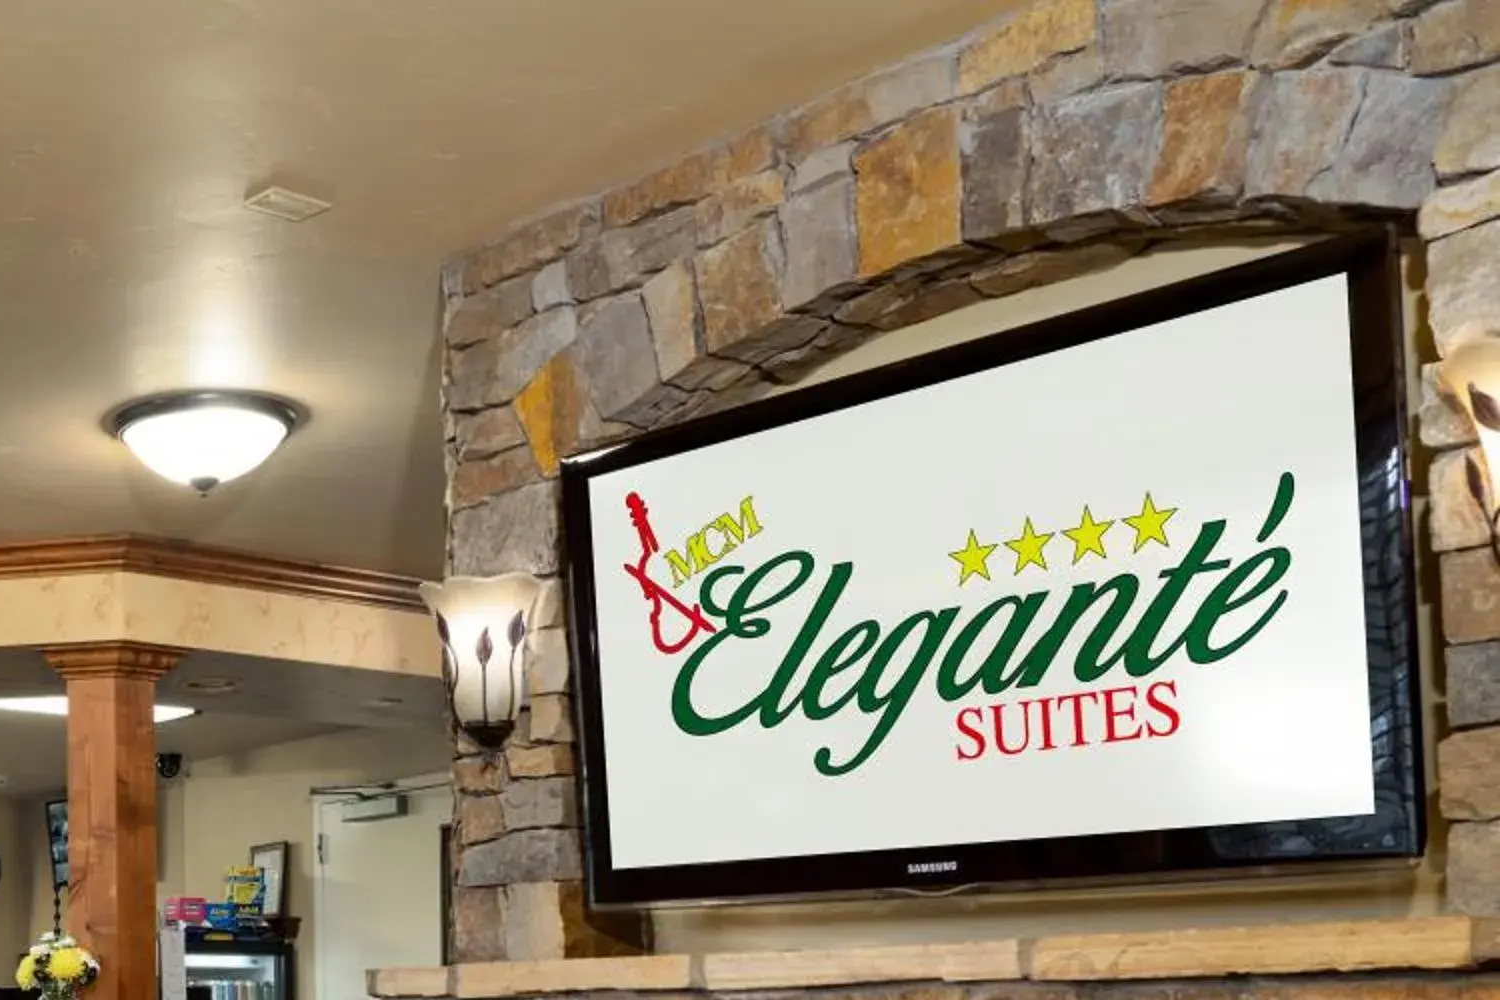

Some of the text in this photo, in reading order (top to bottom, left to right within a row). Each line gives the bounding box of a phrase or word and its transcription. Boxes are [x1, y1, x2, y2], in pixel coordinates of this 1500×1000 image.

[663, 495, 764, 588] MCM
[671, 471, 1295, 776] Eleganté
[956, 681, 1182, 760] SUITES
[907, 861, 957, 874] SAMSUNG
